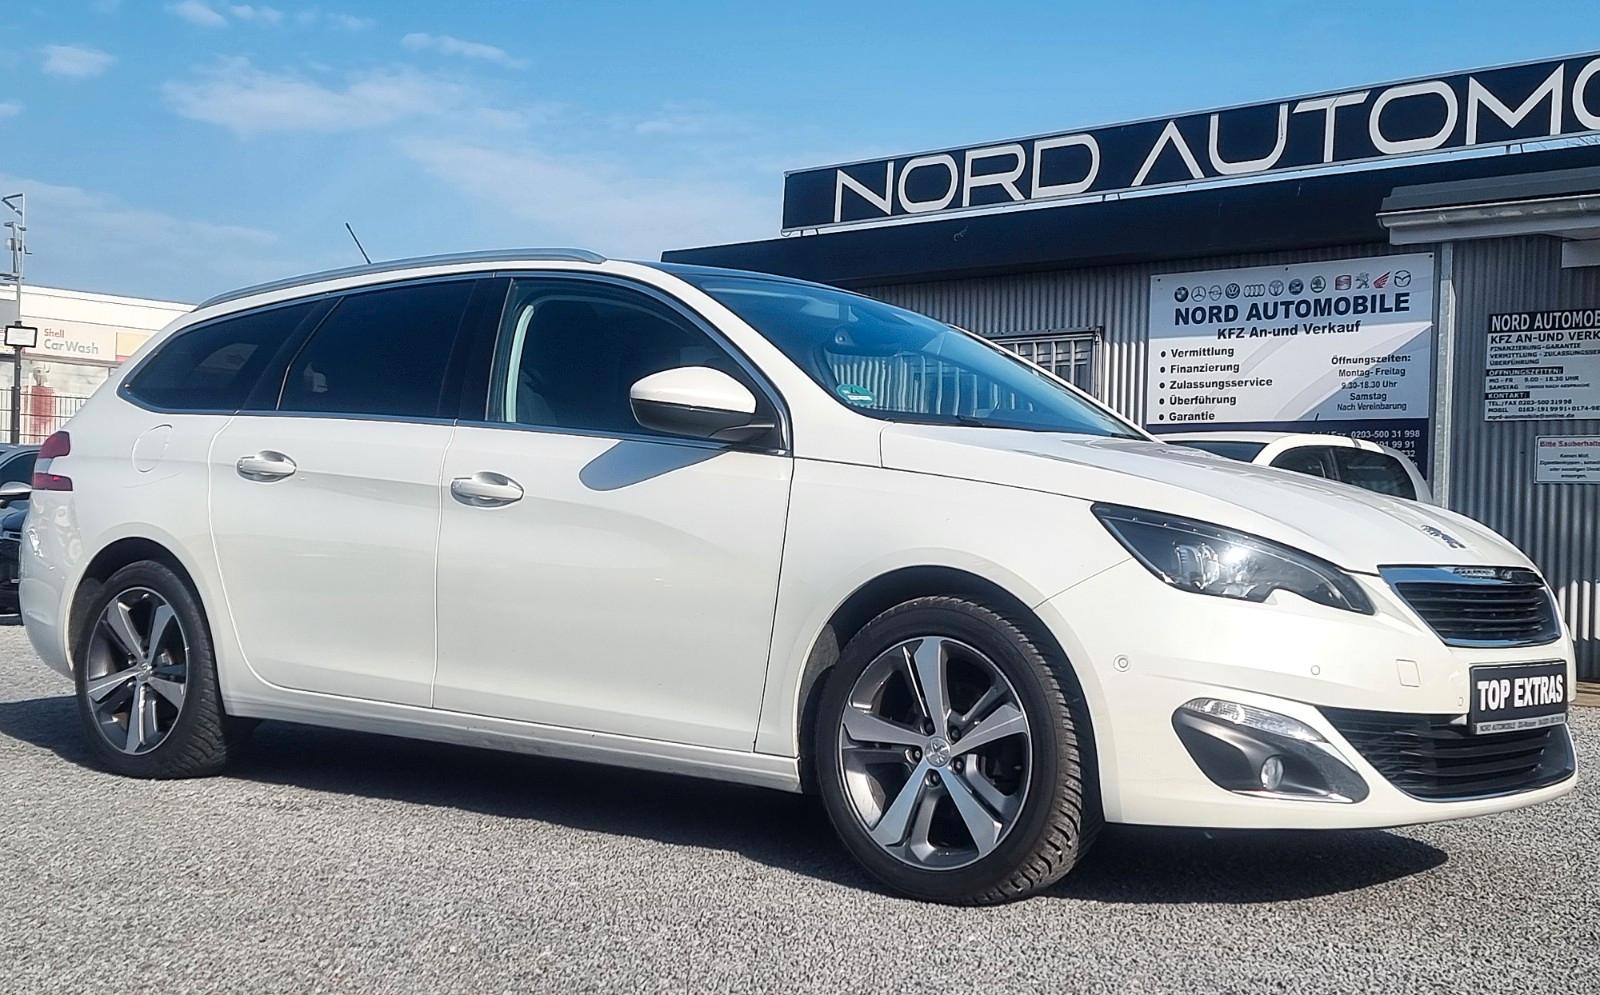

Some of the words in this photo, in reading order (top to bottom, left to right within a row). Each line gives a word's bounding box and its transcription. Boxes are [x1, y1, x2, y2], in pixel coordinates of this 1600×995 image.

[834, 133, 1100, 223] NORD
[1174, 304, 1239, 326] NORD
[1246, 292, 1410, 322] AUTOMOBILE
[1491, 314, 1530, 332] NORD
[44, 328, 65, 338] Shell
[1217, 327, 1245, 340] KFZ
[1249, 325, 1298, 339] An-und
[1303, 320, 1361, 335] Verkauf
[1490, 335, 1513, 344] KFZ
[1516, 331, 1564, 343] AN-UND
[1171, 347, 1234, 359] Vermittlung
[1331, 354, 1411, 365] Öffnungszeiten:
[1170, 362, 1240, 374] Finanzierung
[1375, 367, 1406, 377] Freitag
[1169, 377, 1273, 390] Zulassungsservice
[1382, 380, 1398, 388] Uhr
[1169, 394, 1237, 406] Überführung
[1350, 392, 1387, 401] Samstag
[1337, 403, 1356, 411] Nach
[1357, 402, 1407, 411] Vereinbarung
[1169, 411, 1215, 422] Garantie
[1350, 430, 1389, 438] 0203-500
[1391, 430, 1402, 438] 31
[1404, 430, 1421, 438] 998
[1392, 440, 1402, 448] 99
[1405, 440, 1415, 448] 91
[1477, 679, 1511, 711] TOP
[1514, 674, 1563, 708] EXTRAS
